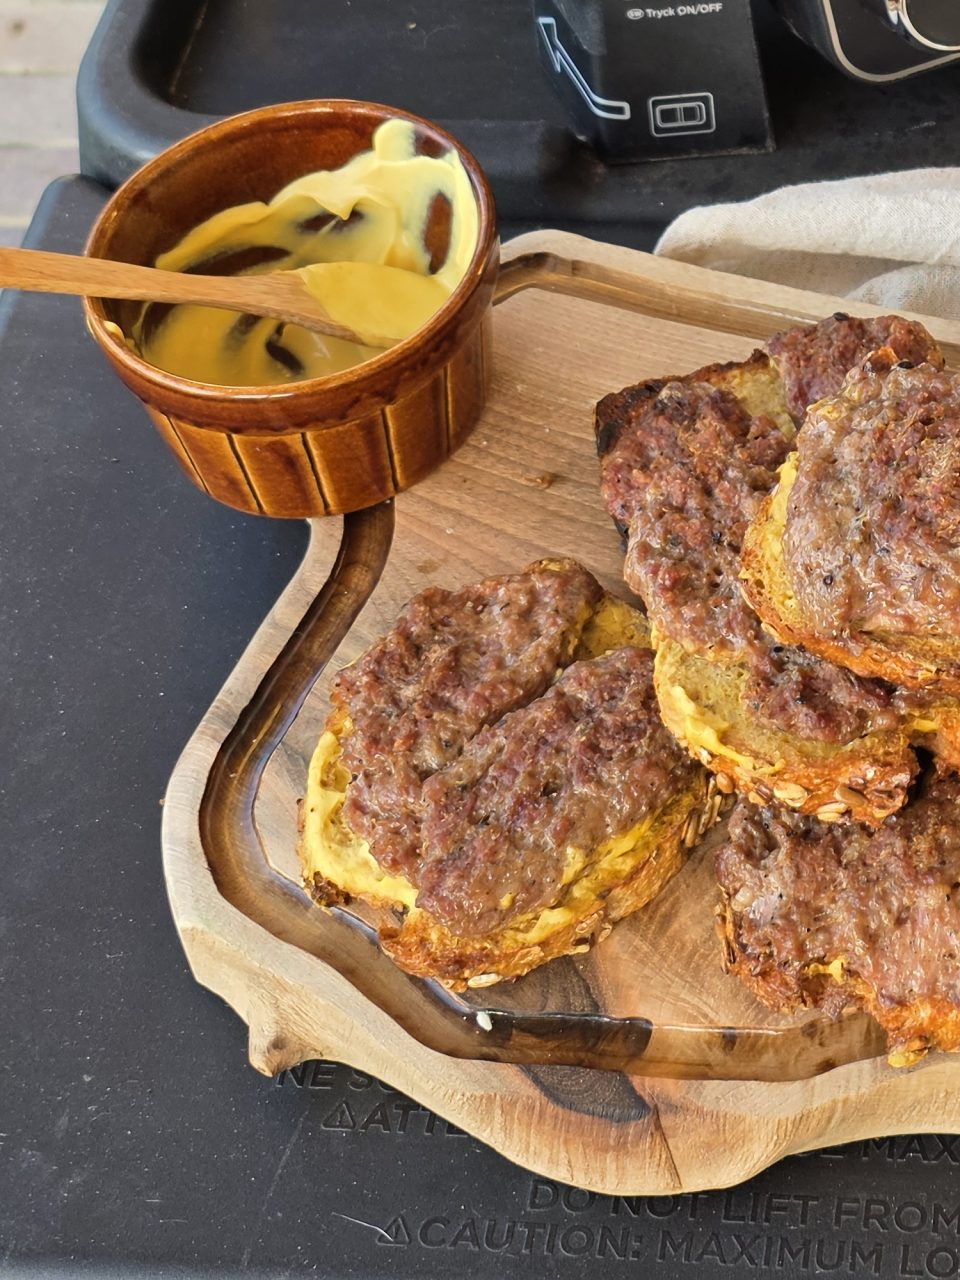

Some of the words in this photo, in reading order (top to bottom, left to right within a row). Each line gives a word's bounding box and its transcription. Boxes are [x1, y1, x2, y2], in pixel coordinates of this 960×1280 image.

[645, 7, 676, 19] Tryck
[677, 3, 723, 16] ON/OFF
[526, 1178, 596, 1217] DO
[610, 1194, 709, 1220] NOT
[722, 1191, 819, 1228] LIFT
[418, 1215, 642, 1261] CAUTION:
[656, 1229, 884, 1275] MAXIMUM
